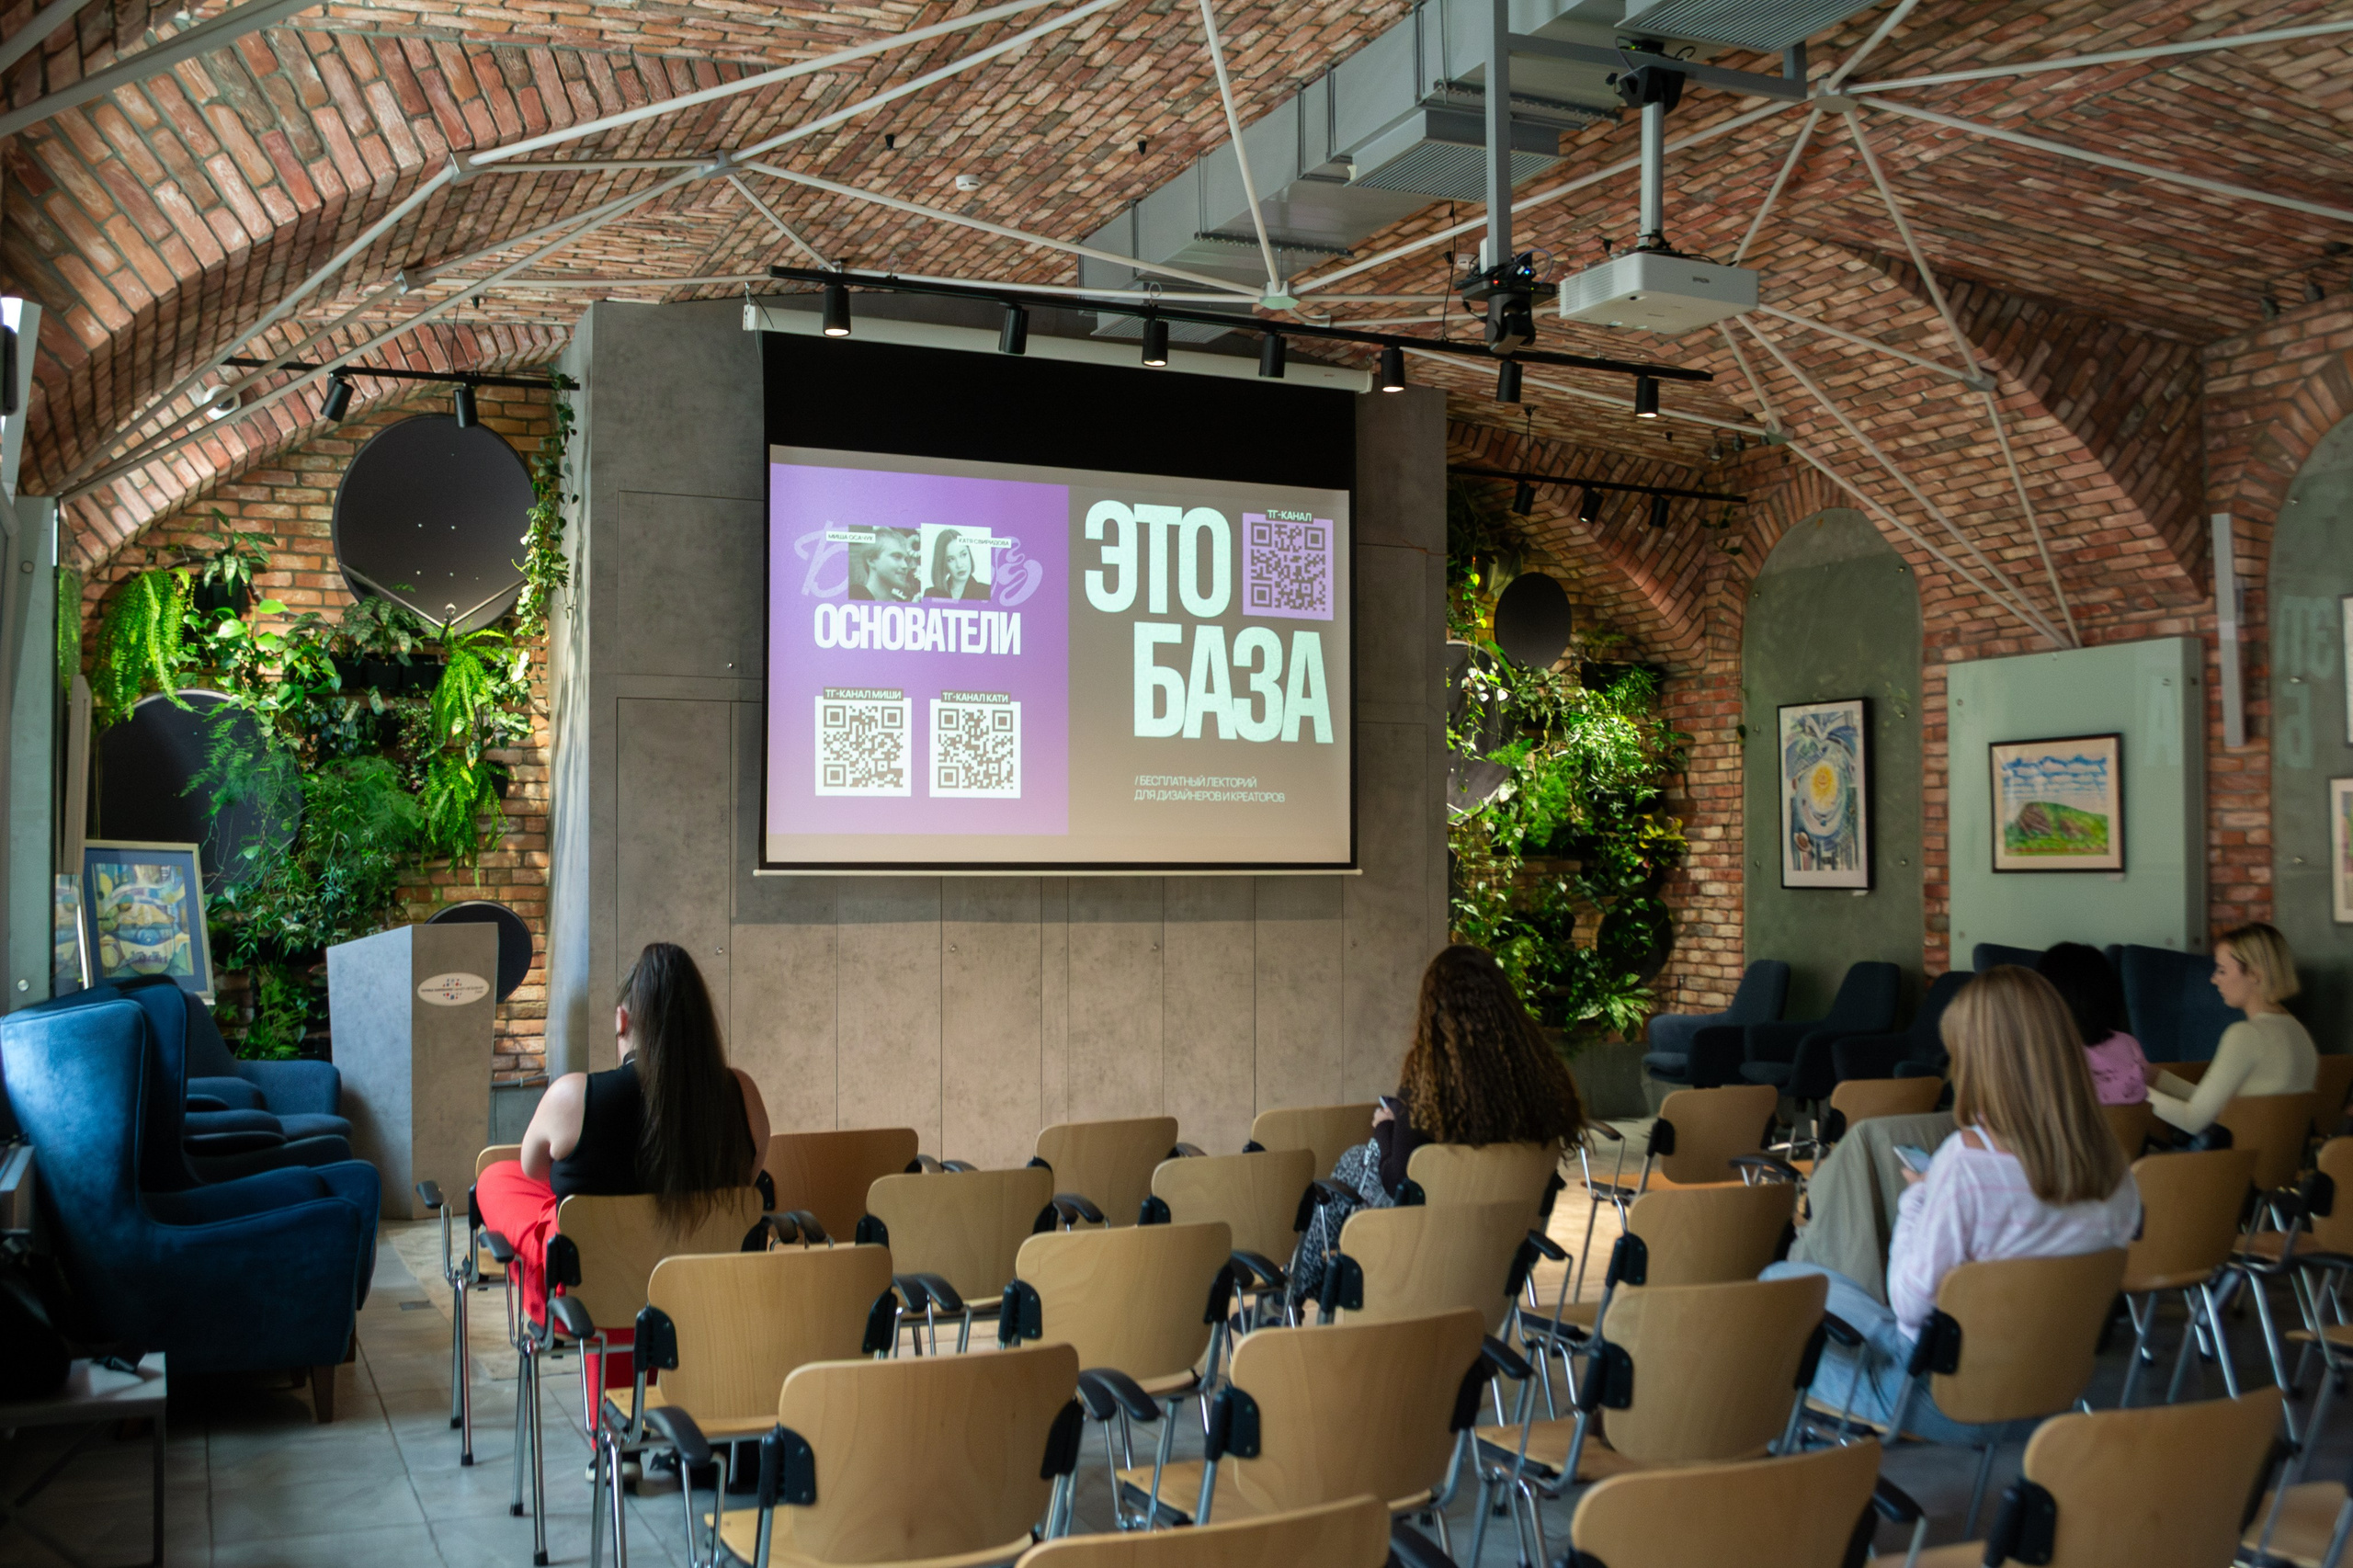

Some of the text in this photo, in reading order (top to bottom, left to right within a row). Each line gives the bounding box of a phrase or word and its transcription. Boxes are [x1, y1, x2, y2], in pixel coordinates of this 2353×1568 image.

[1267, 509, 1312, 522] ТГ-КАНАЛ
[1085, 499, 1232, 618] ЭТО
[814, 603, 1021, 654] ОСНОВАТЕЛИ
[1133, 621, 1334, 744] БАЗА
[825, 689, 902, 699] ТГ-КАНАЛ МИШИ
[943, 692, 1009, 703] ТГ-КАНАЛ КАТИ
[1140, 775, 1206, 787] БЕСПЛАТНЫЙ
[1207, 777, 1257, 788] ЛЕКТОРИЙ
[1134, 789, 1285, 802] ДЛЯ ДИЗАЙНЕРОВ И КРЕАТОРОВ
